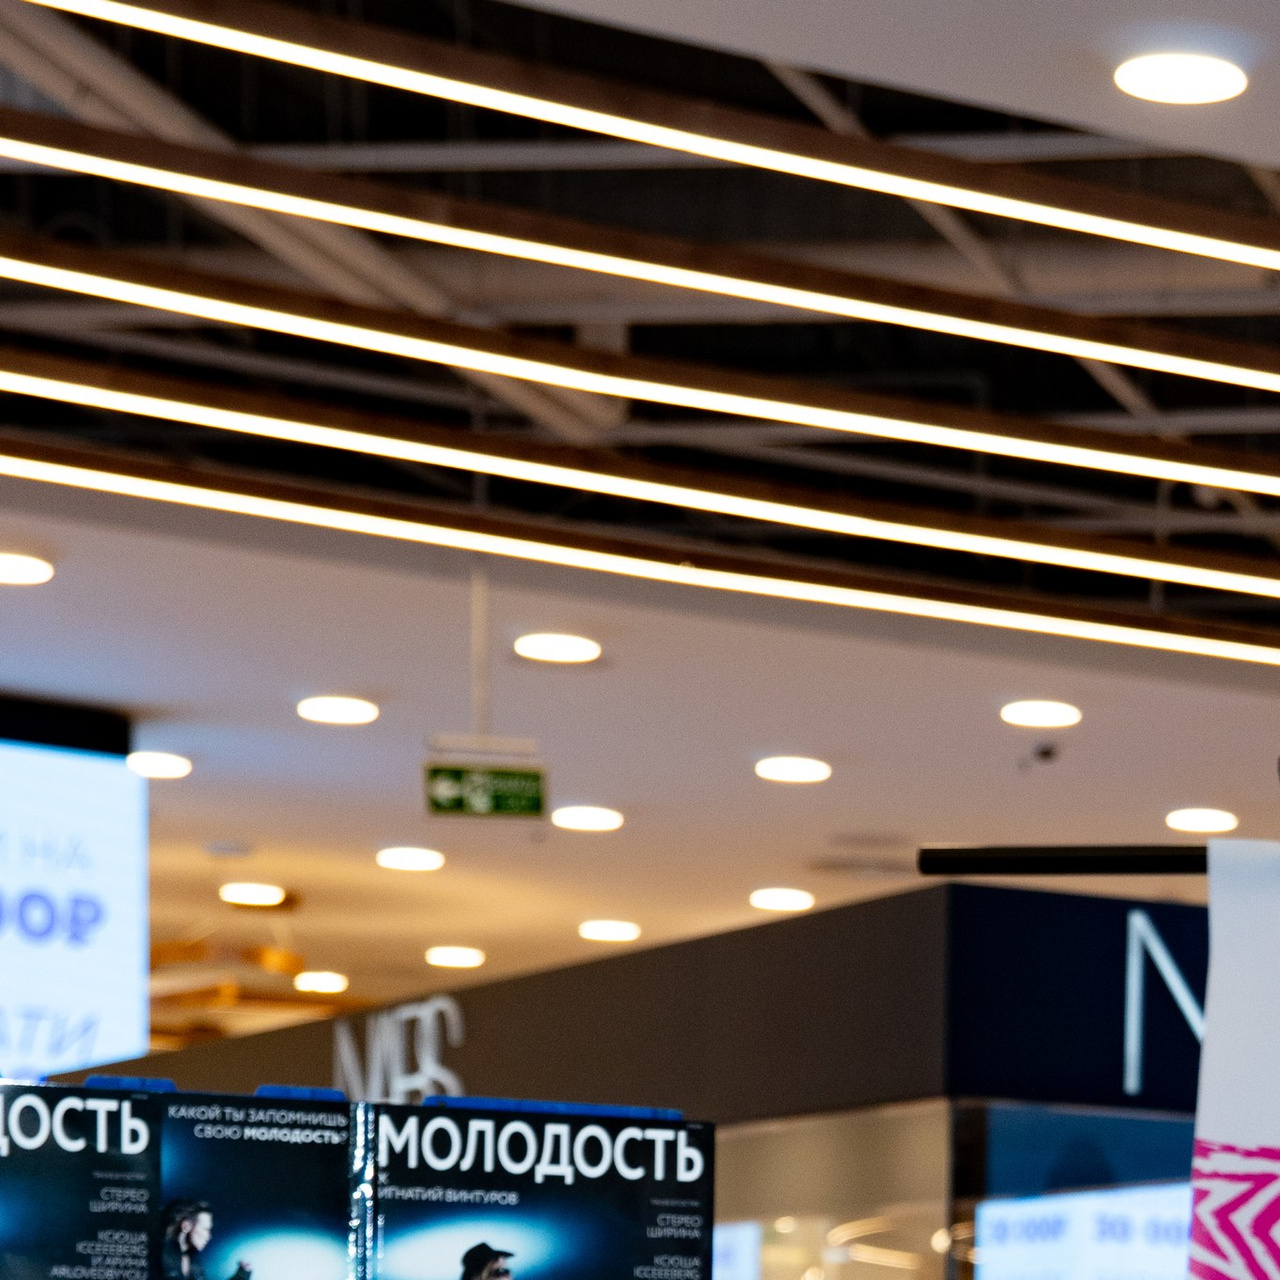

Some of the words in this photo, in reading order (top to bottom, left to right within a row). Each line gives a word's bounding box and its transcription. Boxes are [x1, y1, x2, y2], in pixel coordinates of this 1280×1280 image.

[0, 1094, 149, 1156] ОСТЬ
[168, 1104, 221, 1120] КАКОЙ
[223, 1106, 245, 1122] ТЫ
[247, 1108, 348, 1127] ЗАПОМНИШЬ
[194, 1123, 242, 1139] СВОЮ
[378, 1114, 704, 1185] МОЛОДОСТЬ
[377, 1185, 444, 1202] ИГНАТИЙ
[445, 1188, 520, 1206] ВИНТУРОВ
